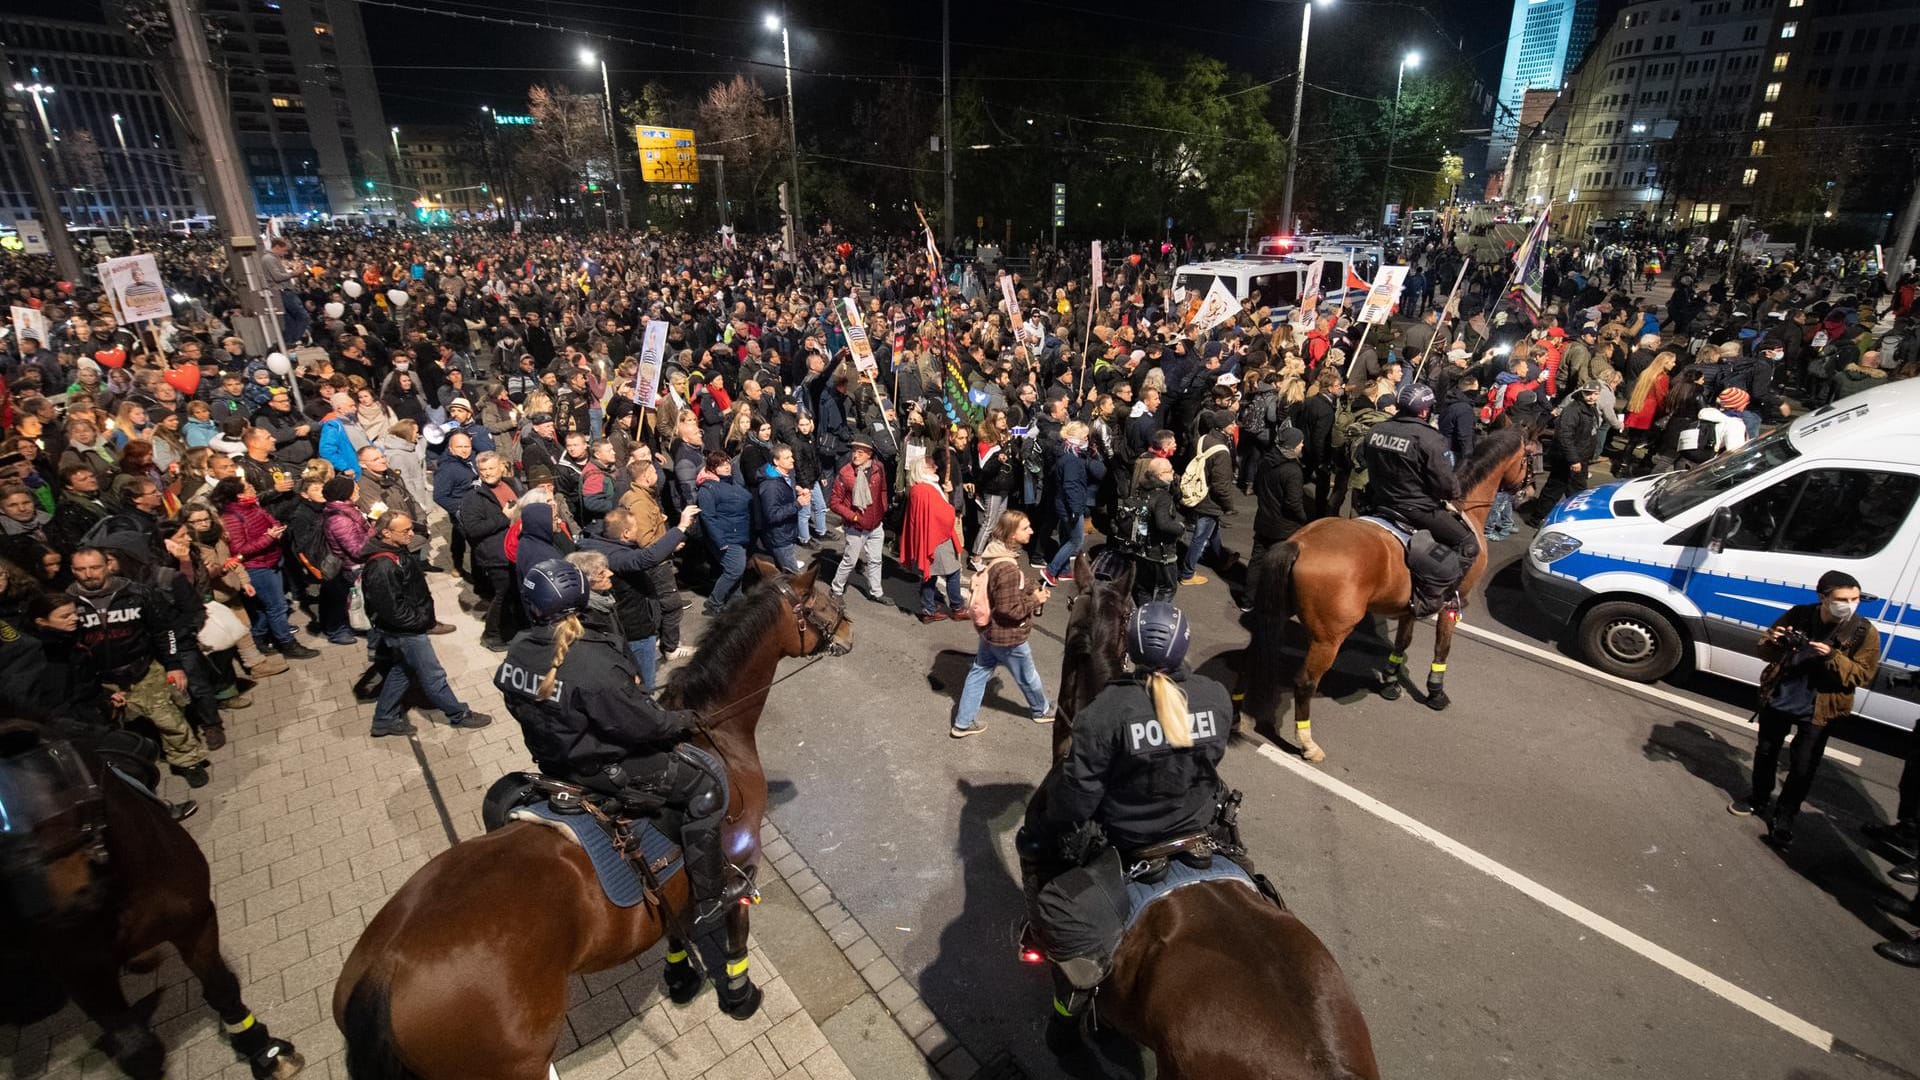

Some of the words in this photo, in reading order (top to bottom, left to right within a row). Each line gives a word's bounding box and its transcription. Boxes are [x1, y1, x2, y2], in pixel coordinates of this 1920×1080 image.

[497, 115, 536, 125] SIEME
[1369, 433, 1410, 453] POLIZEI
[1130, 711, 1217, 750] POZEI
